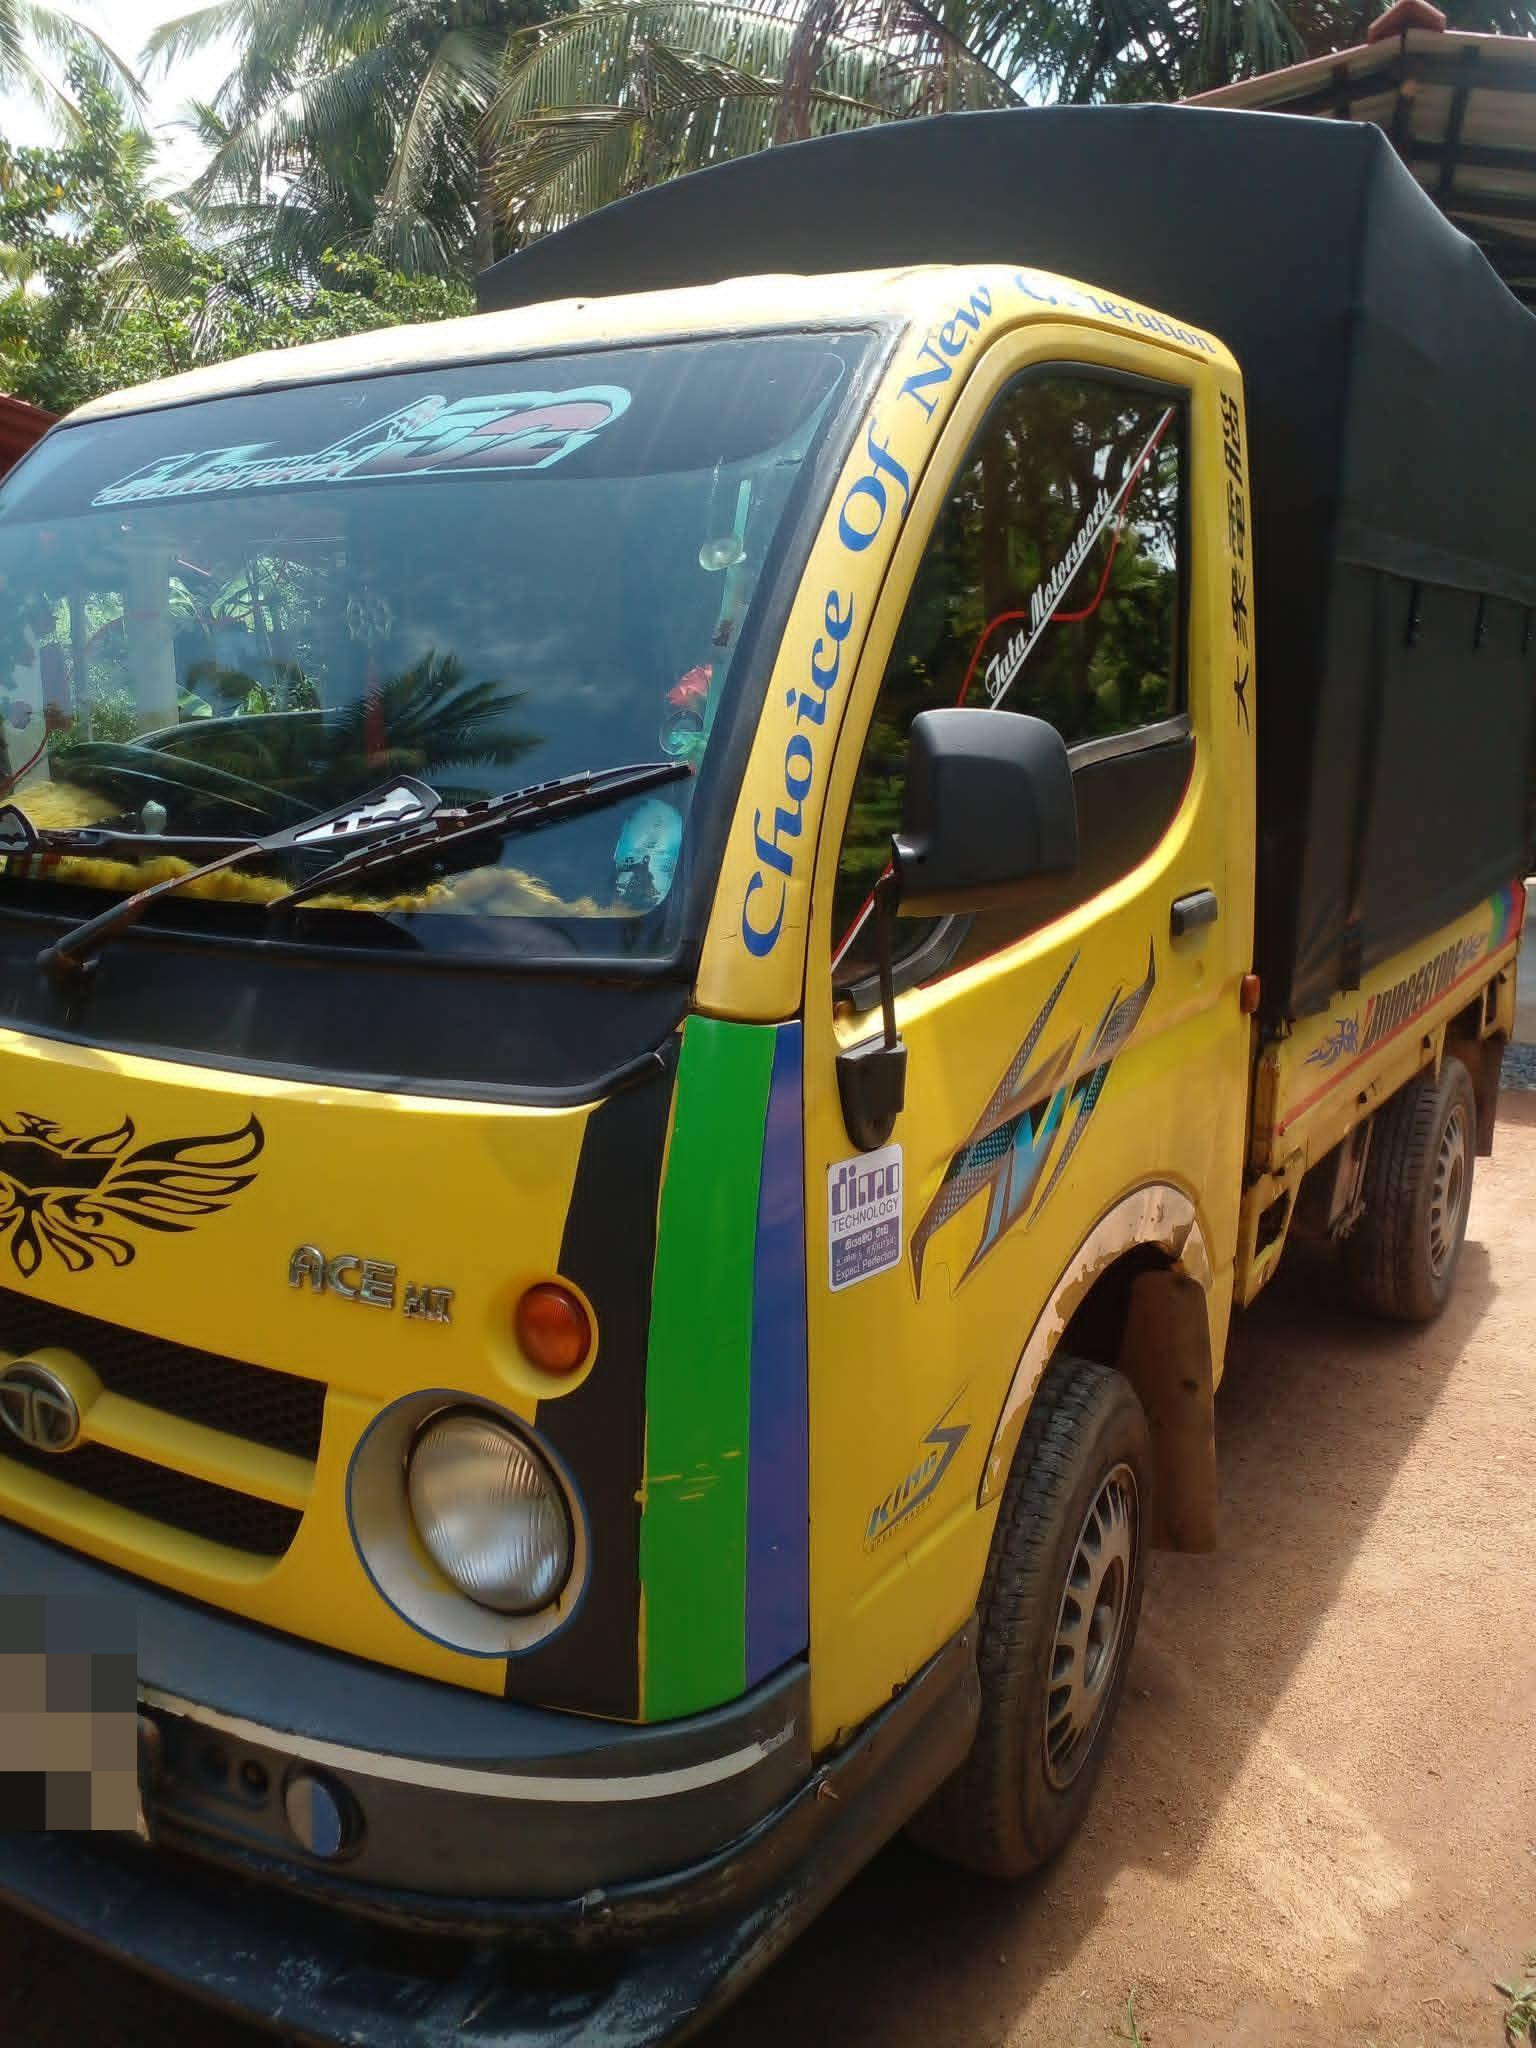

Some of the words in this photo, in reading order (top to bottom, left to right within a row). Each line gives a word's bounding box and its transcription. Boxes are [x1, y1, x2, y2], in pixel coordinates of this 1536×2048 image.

[741, 589, 855, 957] Choice
[838, 416, 911, 553] Of
[896, 284, 993, 424] New
[984, 628, 1028, 699] Tata
[1027, 486, 1112, 637] Motorsports
[287, 1244, 397, 1311] ACE
[831, 1197, 900, 1234] TECHNOLOGY
